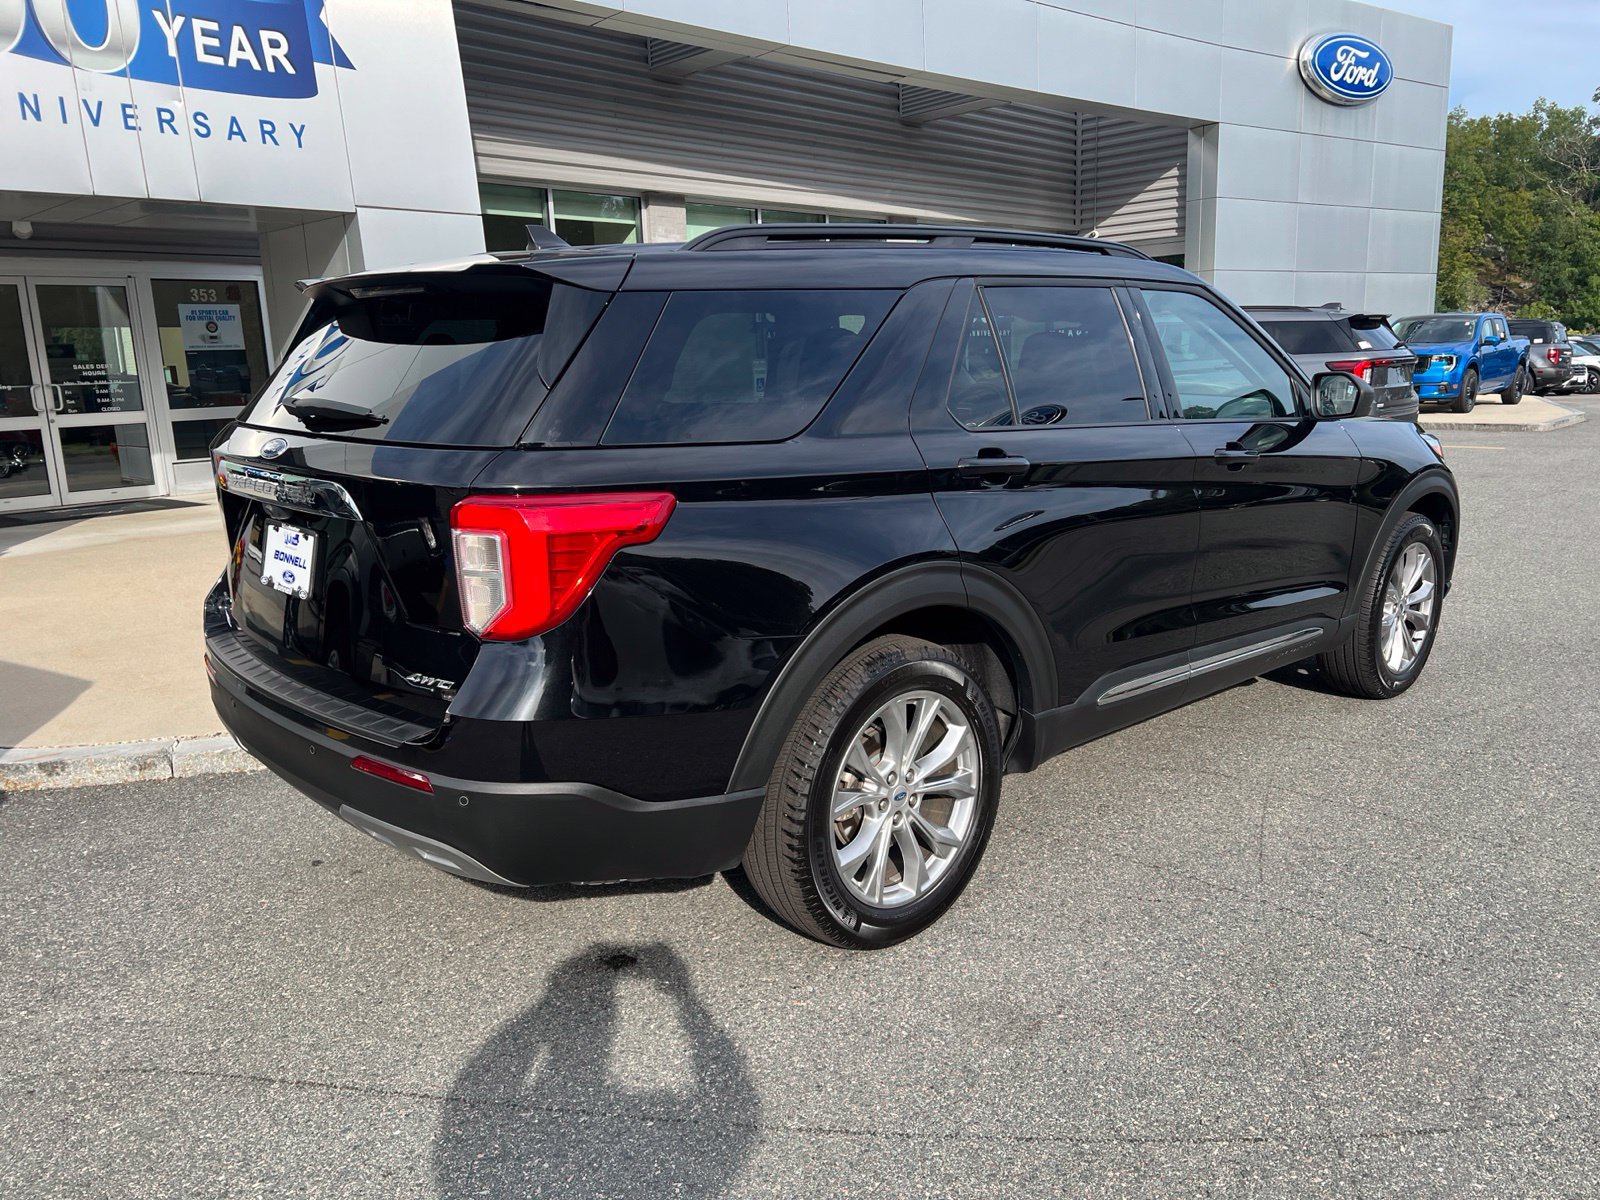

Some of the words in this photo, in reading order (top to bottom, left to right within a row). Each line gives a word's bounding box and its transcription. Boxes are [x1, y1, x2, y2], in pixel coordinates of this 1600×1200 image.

[152, 10, 296, 75] YEAR
[1330, 45, 1380, 88] Ford
[190, 288, 217, 302] 353
[273, 549, 307, 570] BONNELL
[815, 841, 844, 911] MICHELIN
